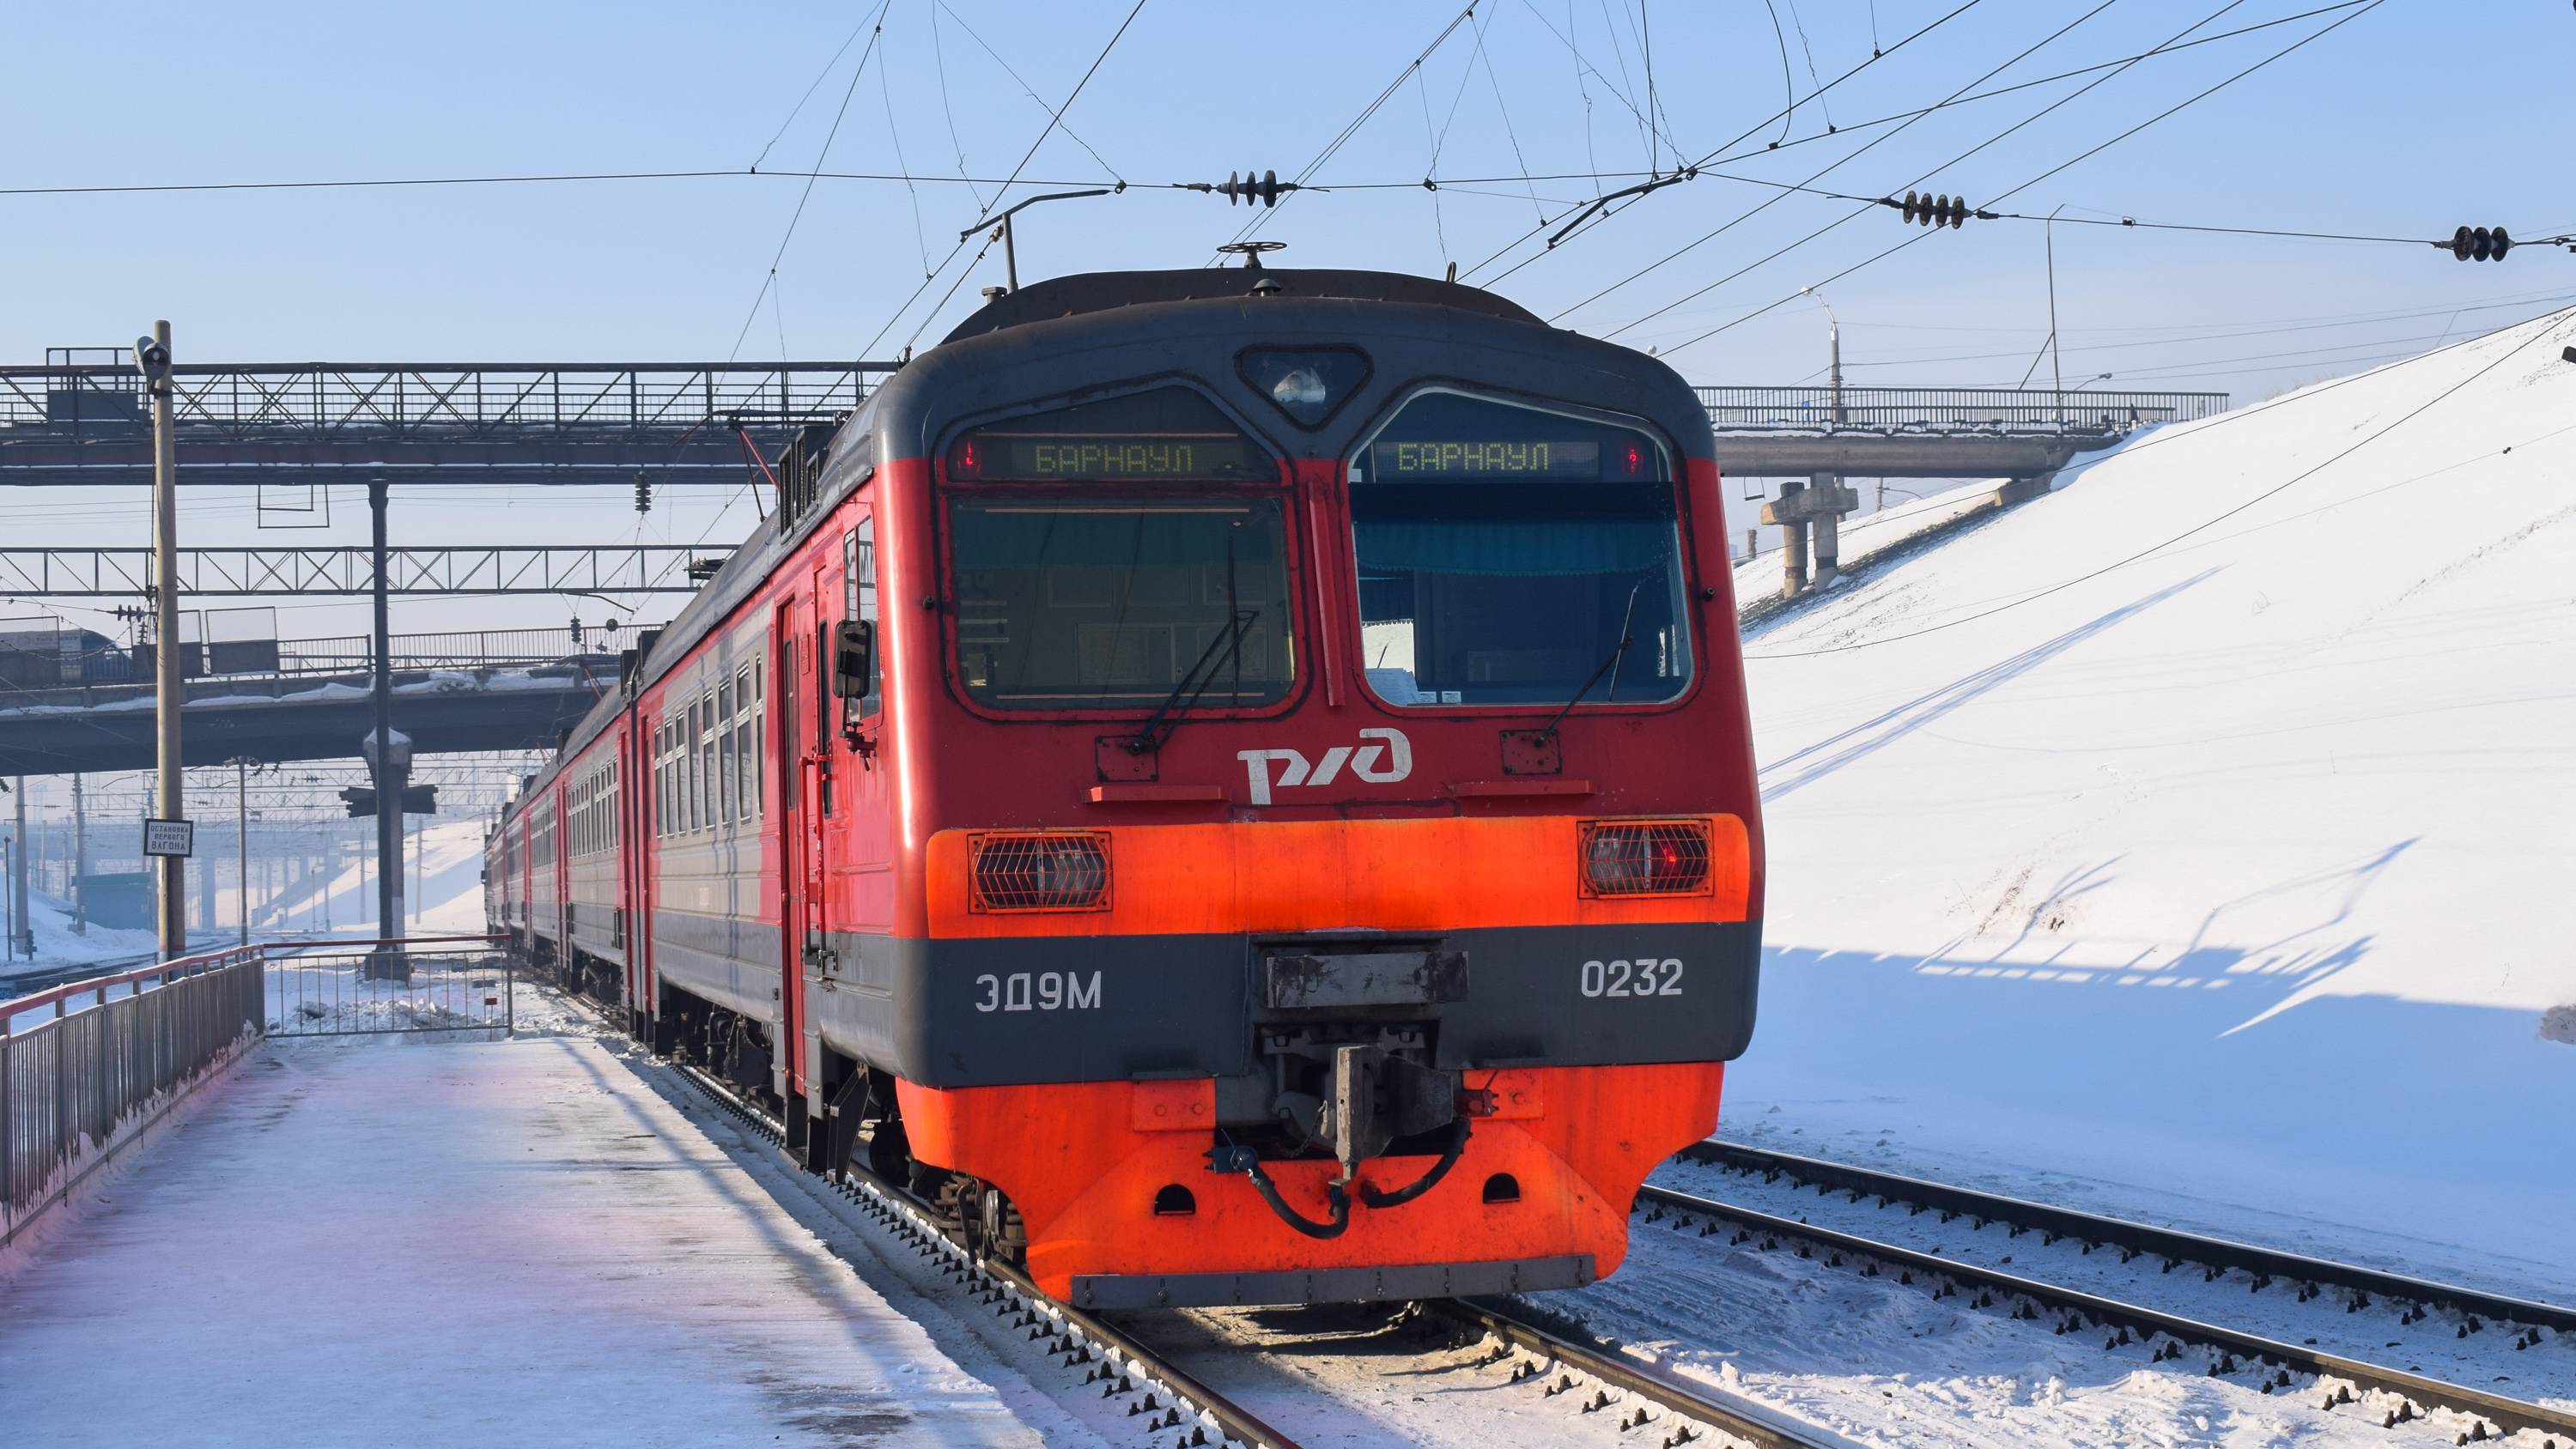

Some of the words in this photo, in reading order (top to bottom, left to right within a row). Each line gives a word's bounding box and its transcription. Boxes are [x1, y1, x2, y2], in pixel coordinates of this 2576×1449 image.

[1036, 444, 1193, 472] БАРНАУЛ
[1398, 443, 1549, 470] БАРНАУЛ
[151, 841, 185, 851] ВАГОНА
[975, 971, 1102, 1012] ЭД9М
[1581, 958, 1683, 997] 0232
